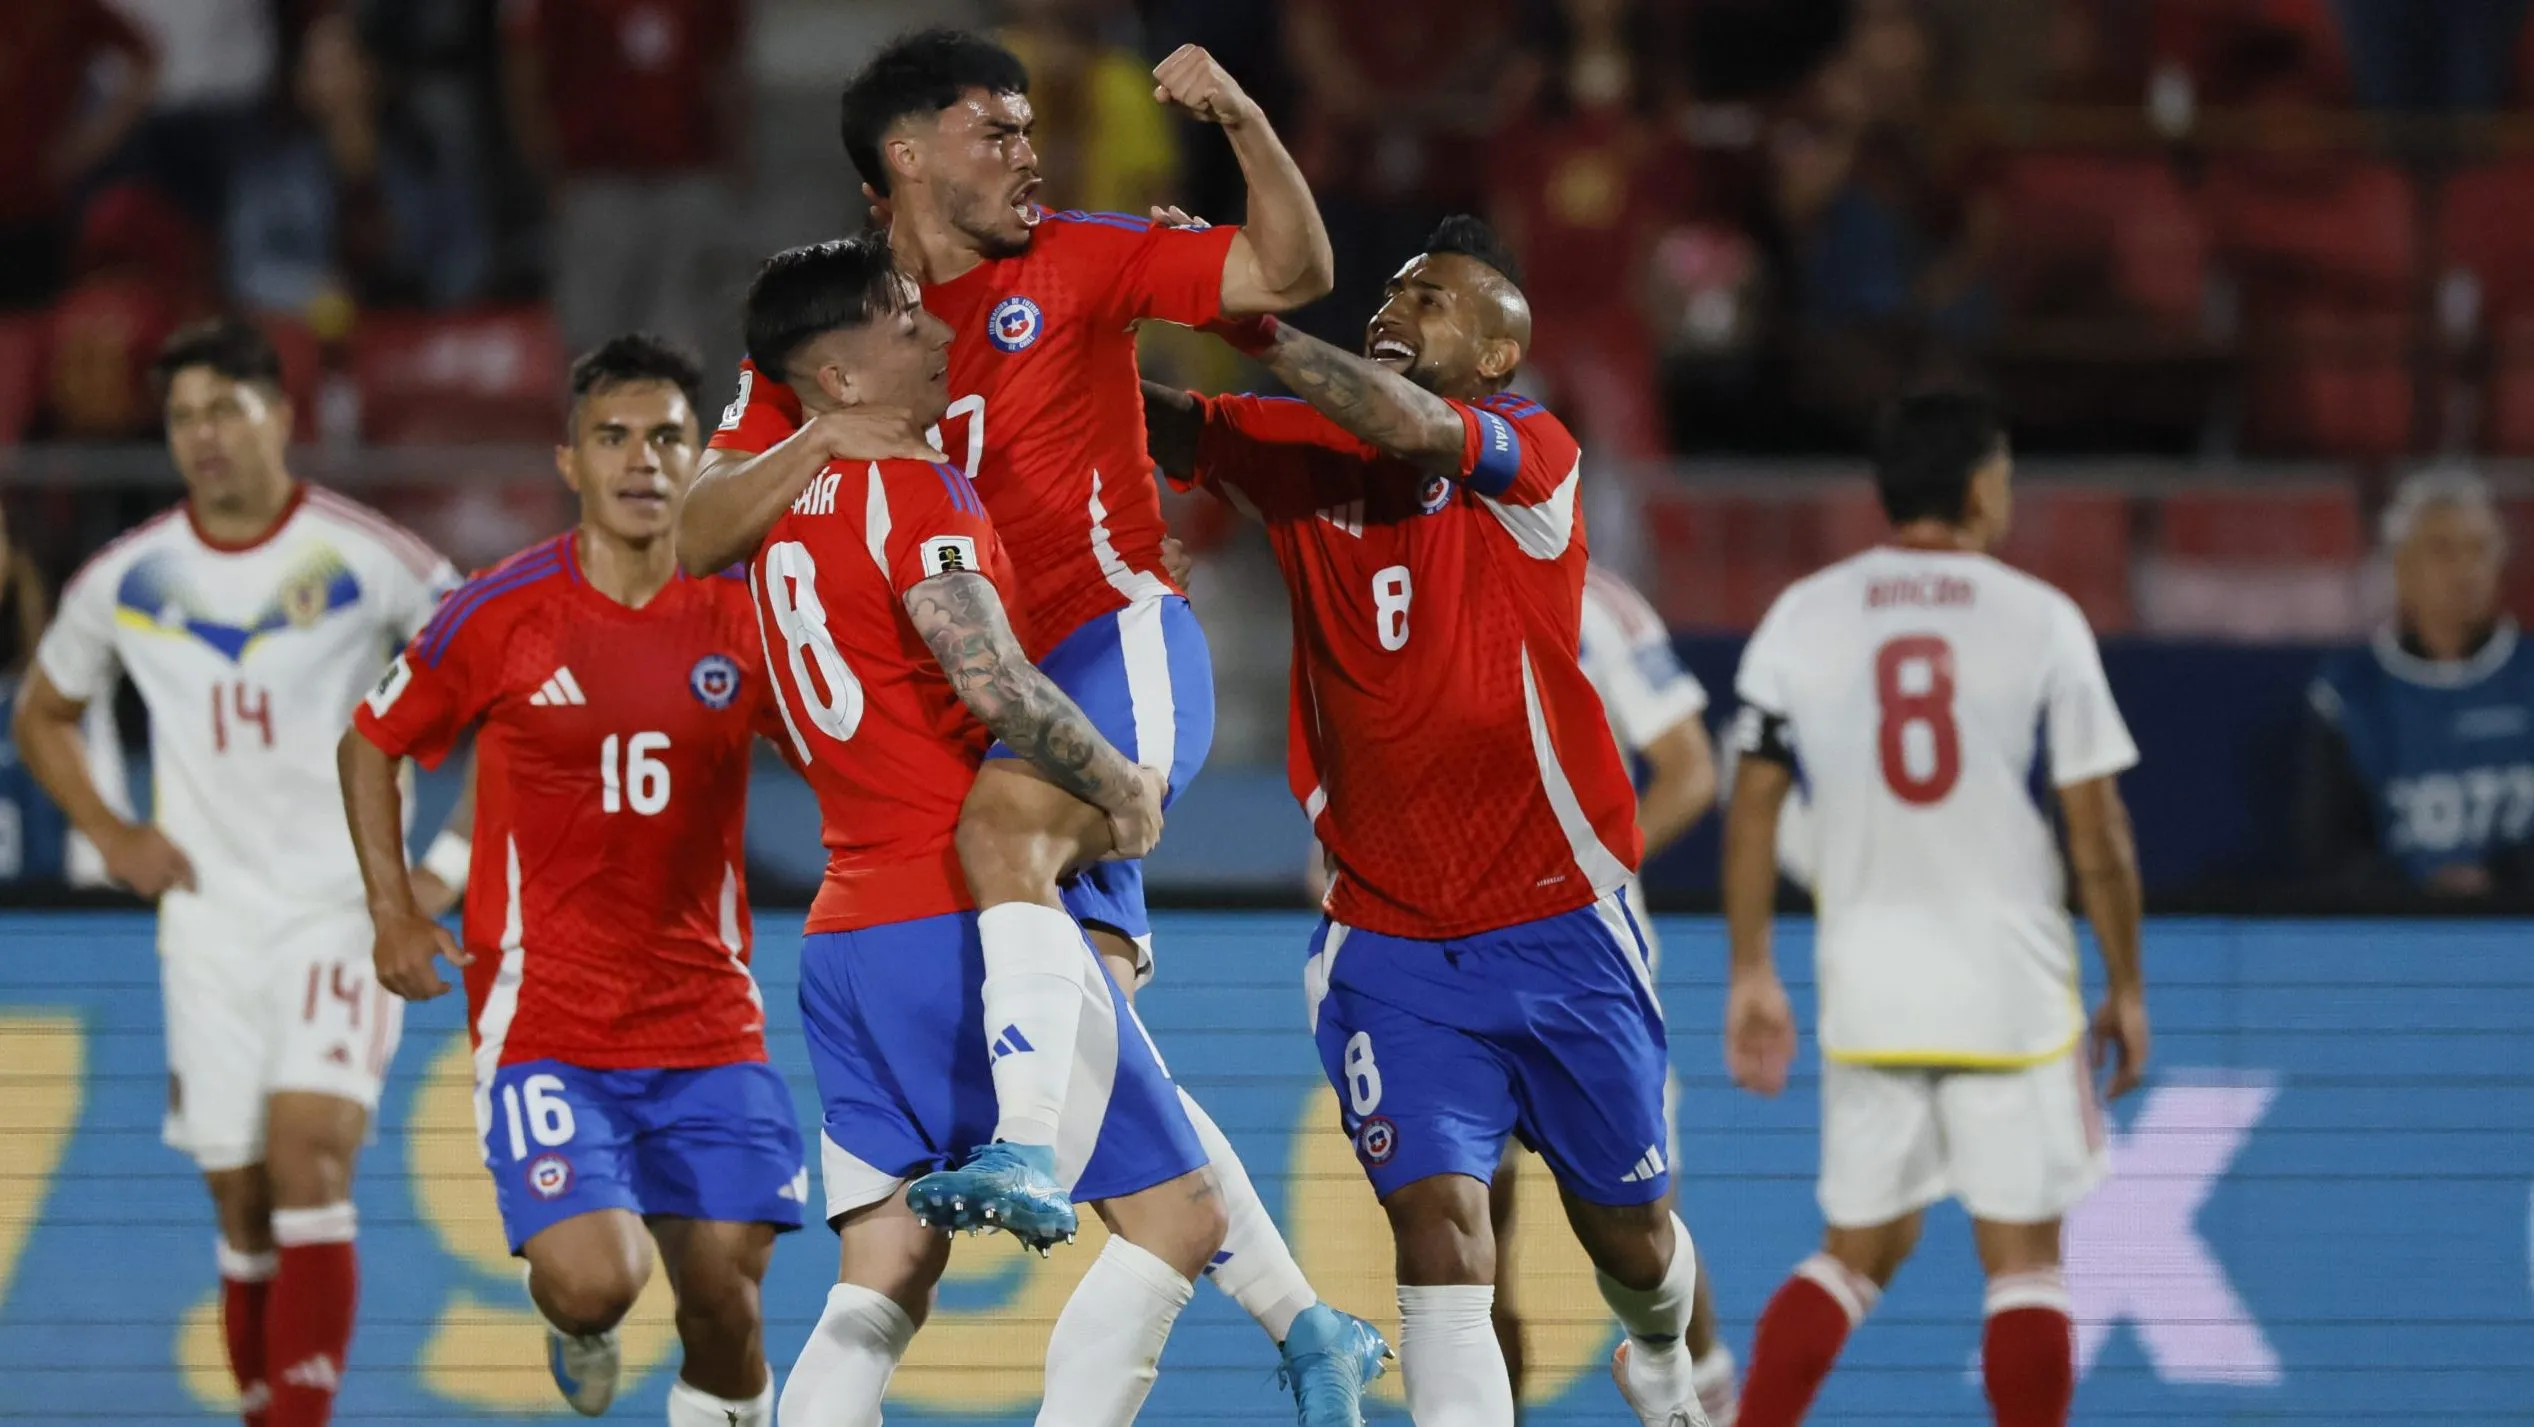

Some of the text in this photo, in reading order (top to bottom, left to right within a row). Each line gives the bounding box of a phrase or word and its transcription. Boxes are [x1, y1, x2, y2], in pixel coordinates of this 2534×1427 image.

[1371, 564, 1413, 652] 8
[211, 680, 277, 754] 14
[1875, 632, 1963, 806] 8
[601, 731, 671, 816] 16
[303, 960, 364, 1031] 14
[1344, 1031, 1382, 1117] 8
[503, 1073, 576, 1162] 16
